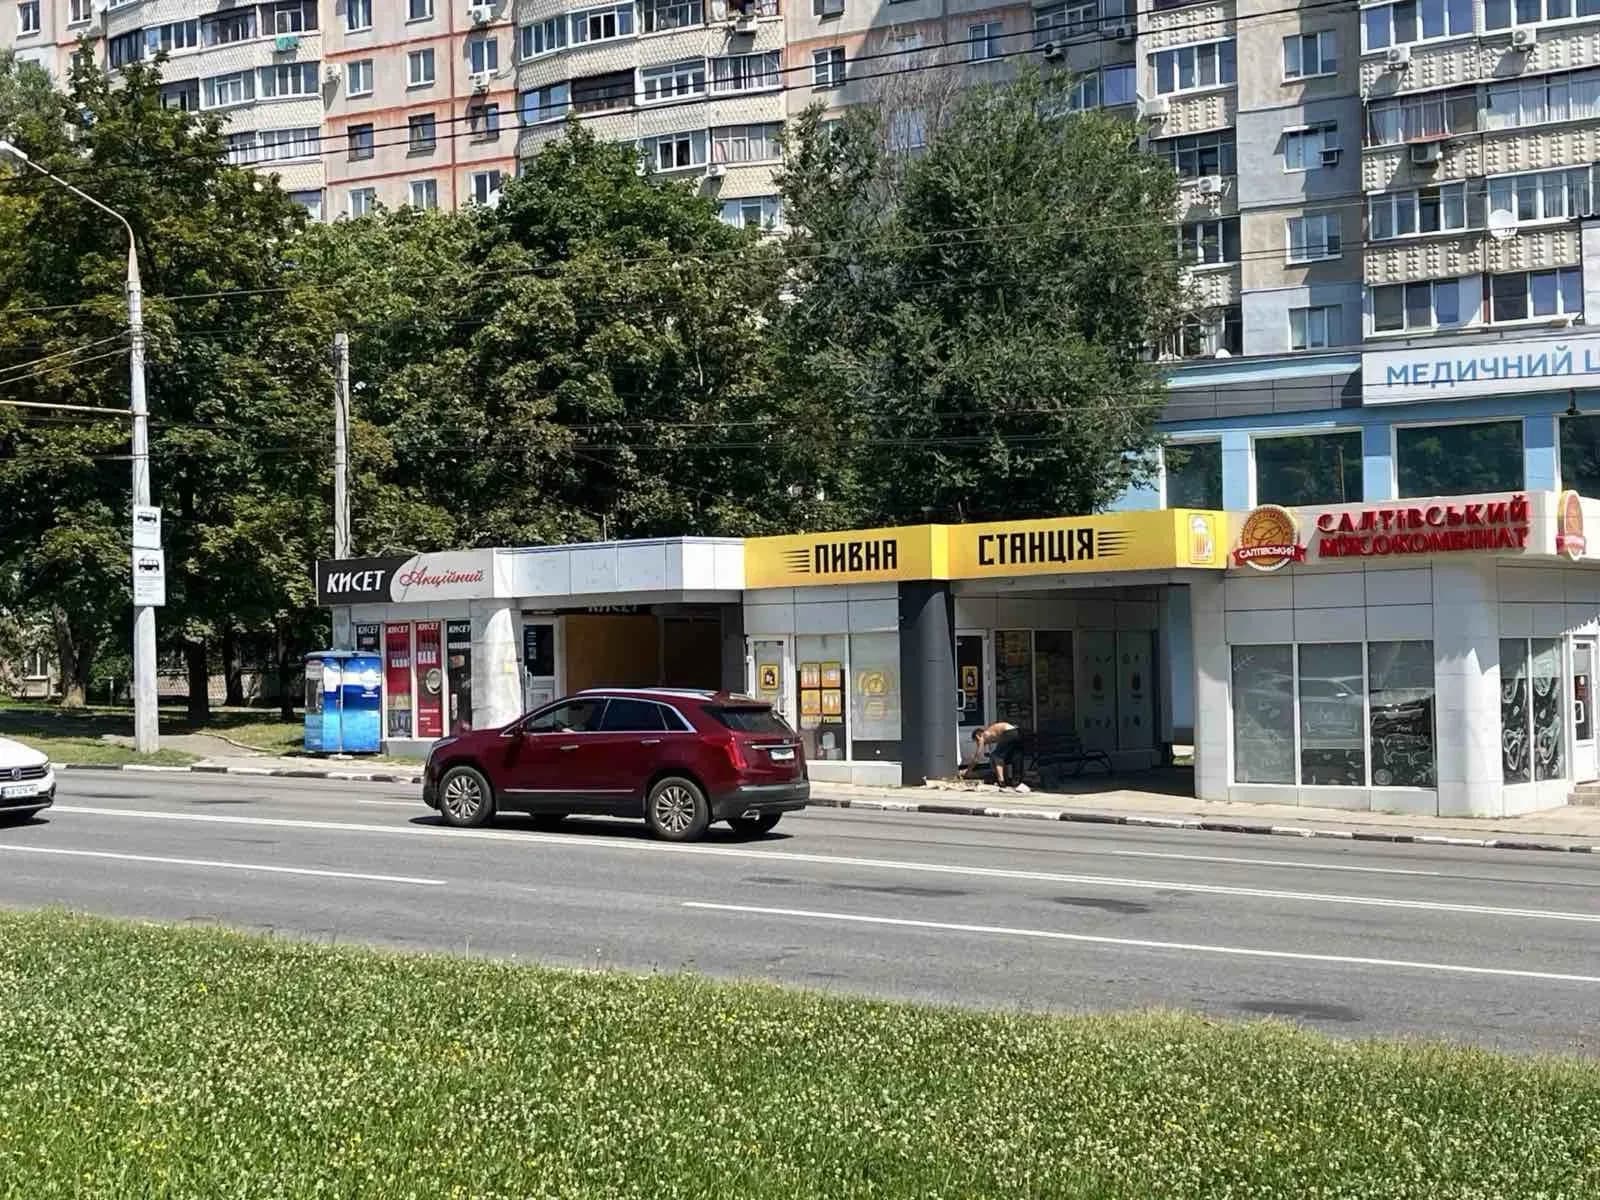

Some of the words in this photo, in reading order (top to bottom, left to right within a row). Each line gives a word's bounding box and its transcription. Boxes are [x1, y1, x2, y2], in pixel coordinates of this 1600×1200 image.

[1386, 344, 1573, 389] МЕДИЧНИЙ
[1317, 495, 1529, 533] САЛТІВСЬКИЙ
[814, 539, 898, 574] ПИВНА
[978, 527, 1095, 565] СТАНЦІЯ
[326, 570, 386, 593] КИСЕТ
[399, 565, 484, 588] Акційний
[387, 624, 409, 634] КИСЕТ
[417, 622, 439, 631] КИСЕТ
[448, 624, 470, 634] КИСЕТ
